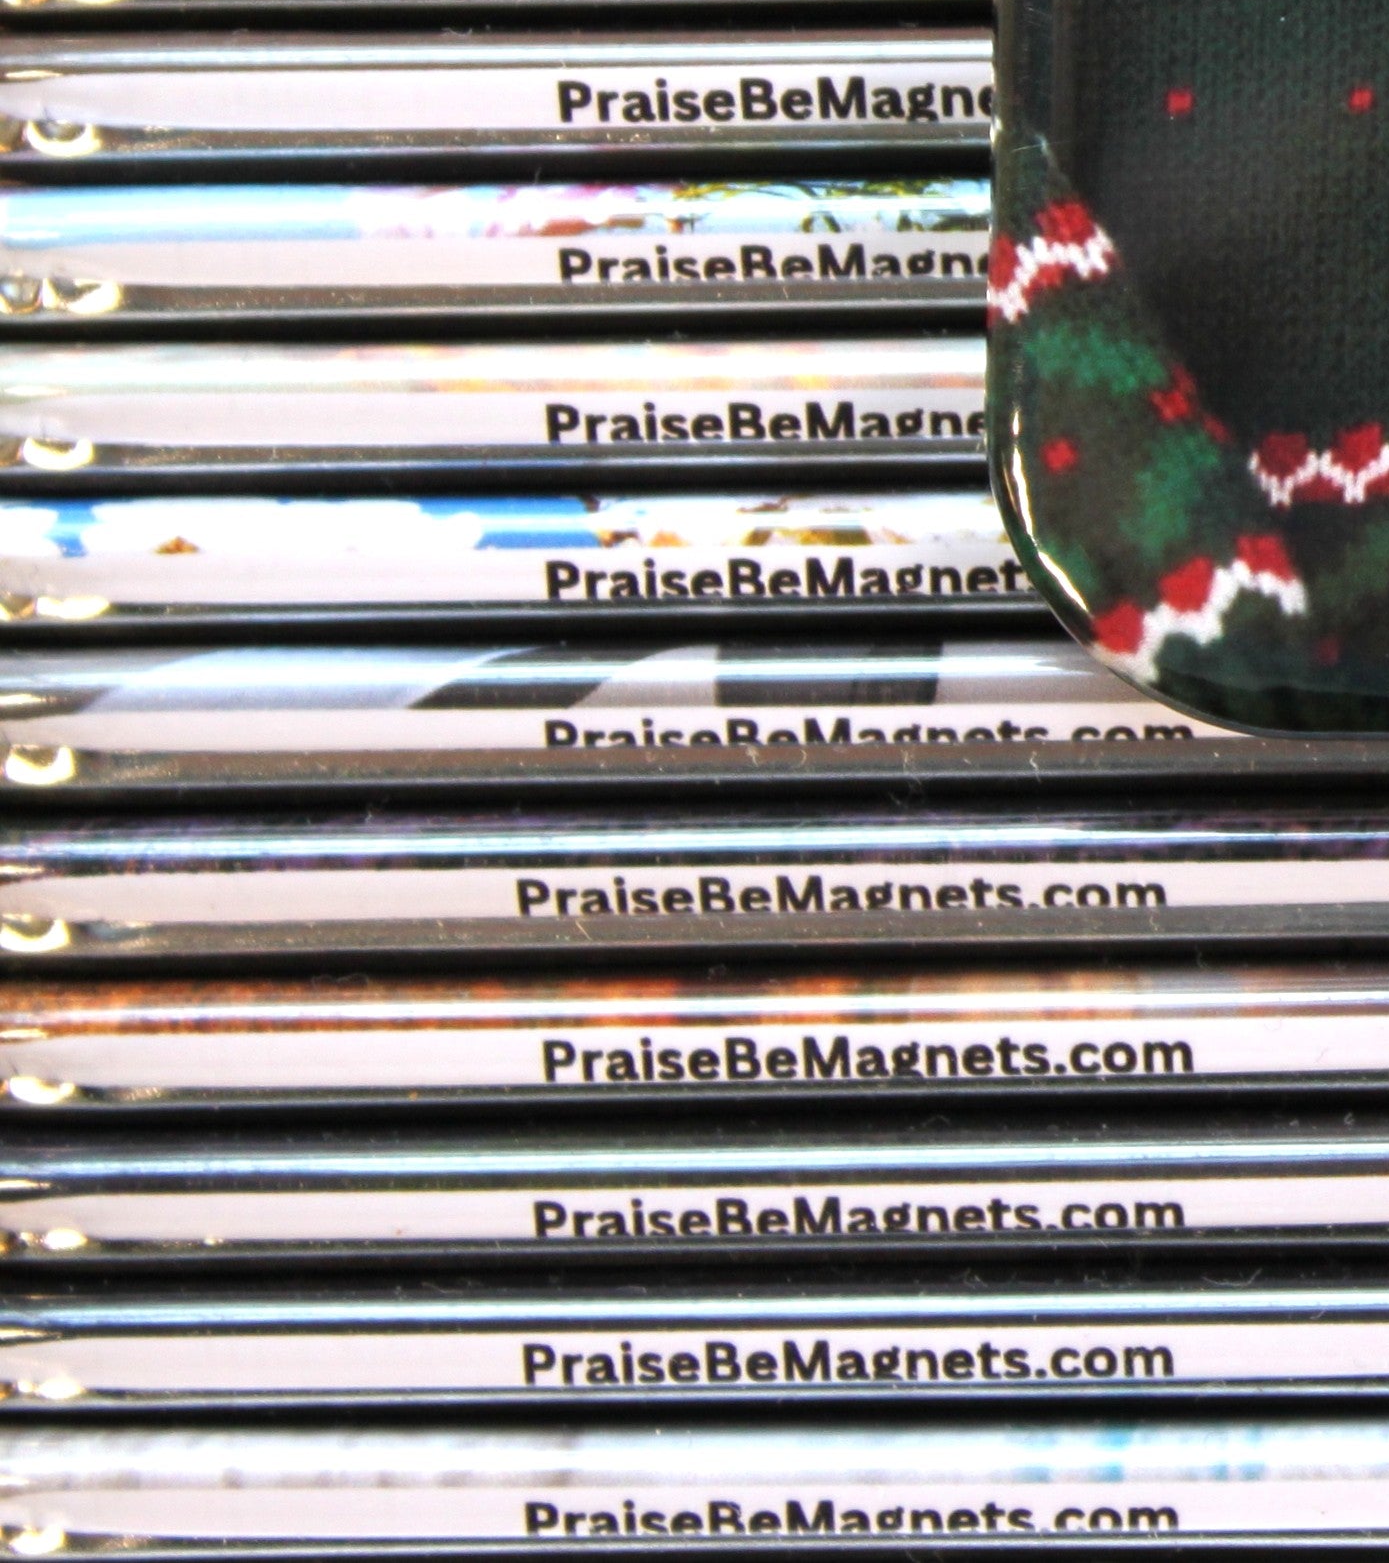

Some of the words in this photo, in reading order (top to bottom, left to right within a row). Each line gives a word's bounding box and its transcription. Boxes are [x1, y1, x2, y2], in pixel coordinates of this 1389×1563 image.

[546, 558, 1035, 602] PraiseBeMagnet
[543, 1036, 1194, 1083] PraiseBeMagnets.com
[523, 1339, 1174, 1385] PraiseBeMagnets.com
